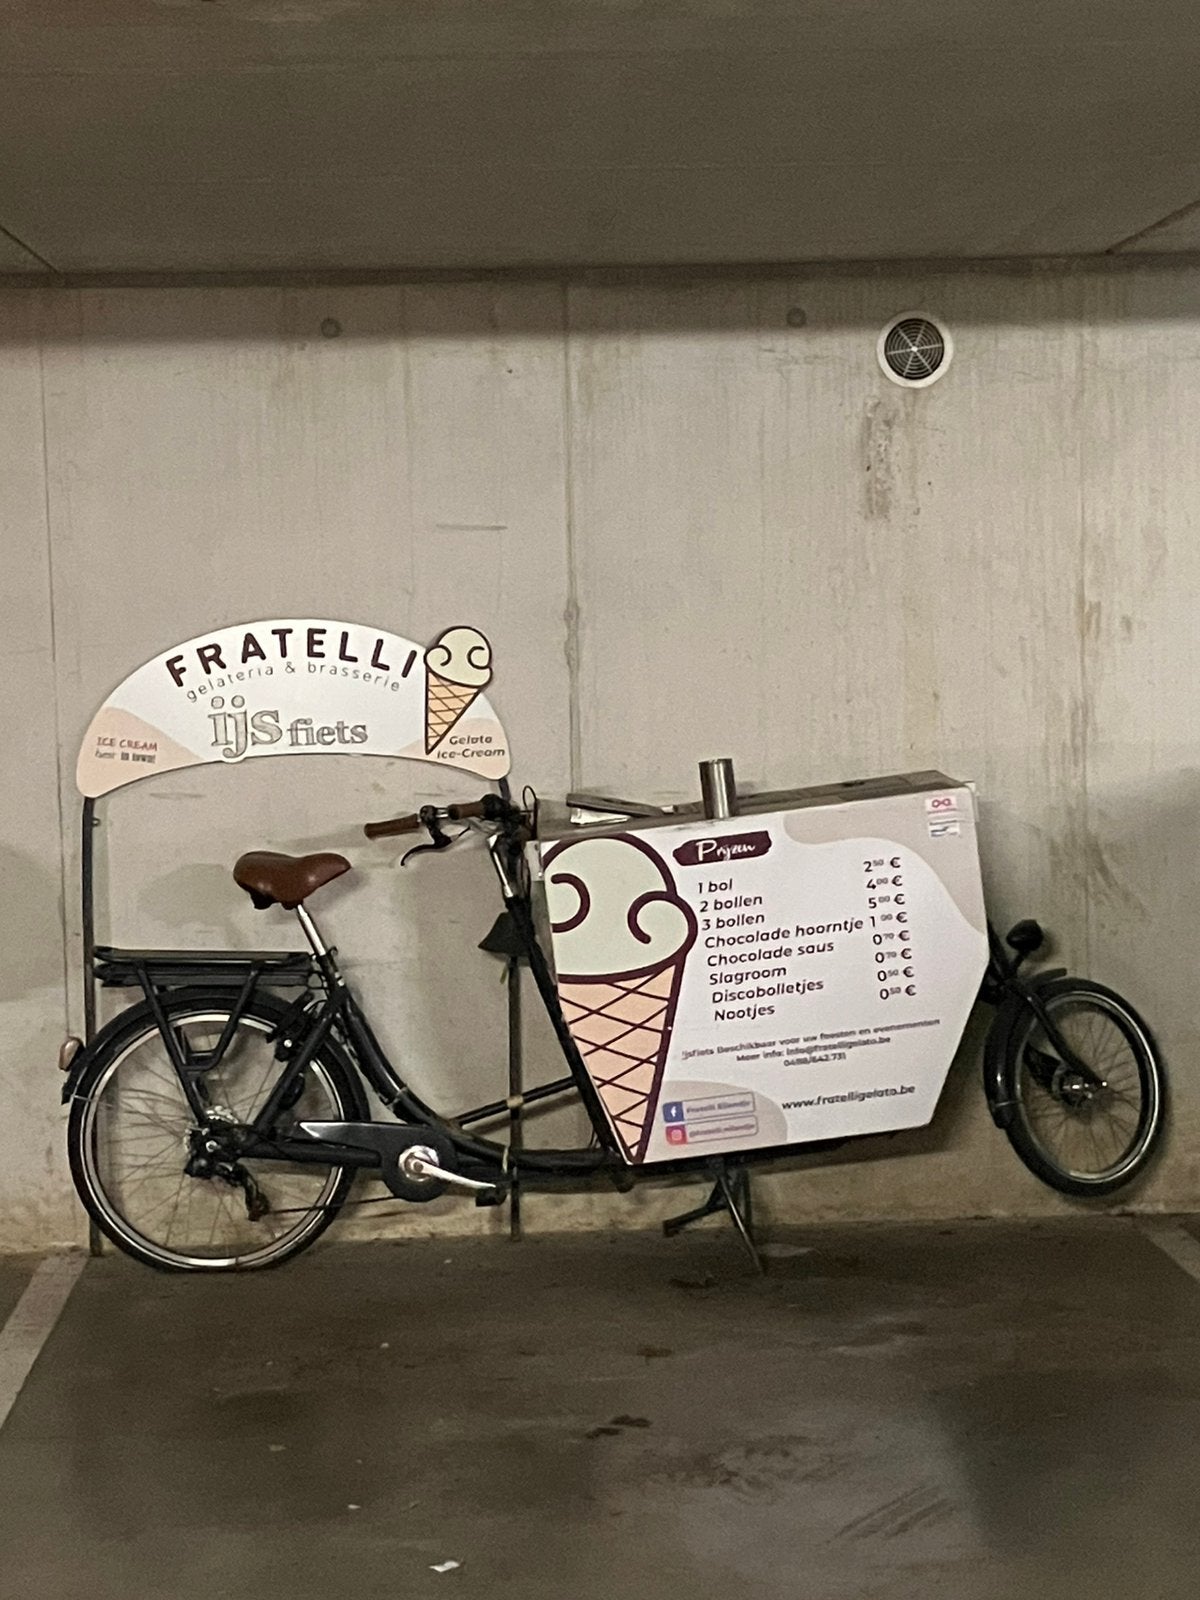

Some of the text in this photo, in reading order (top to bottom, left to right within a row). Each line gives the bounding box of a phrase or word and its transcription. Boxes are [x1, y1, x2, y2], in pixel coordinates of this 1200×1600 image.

[165, 627, 418, 688] FRATELLI
[187, 661, 400, 703] gelateria & brasserie
[96, 736, 158, 752] ICE CREAM
[207, 694, 369, 759] ijs fiets
[449, 735, 493, 746] Gelato
[697, 882, 704, 895] 1
[708, 878, 734, 894] bol
[889, 856, 902, 869] €
[699, 900, 711, 914] 2
[713, 895, 764, 912] bollen
[891, 875, 904, 888] €
[701, 918, 712, 932] 3
[715, 913, 766, 930] bollen
[893, 893, 906, 906] €
[704, 927, 791, 949] Chocolade
[795, 917, 865, 938] hoorntje
[895, 912, 909, 924] €
[707, 945, 793, 967] Chocolade
[797, 941, 835, 956] saus
[897, 930, 911, 942] €
[709, 966, 787, 986] Slagroom
[900, 948, 913, 960] €
[712, 979, 824, 1004] Discobolletjes
[902, 966, 916, 978] €
[714, 1003, 776, 1022] Nootjes
[905, 984, 918, 997] €
